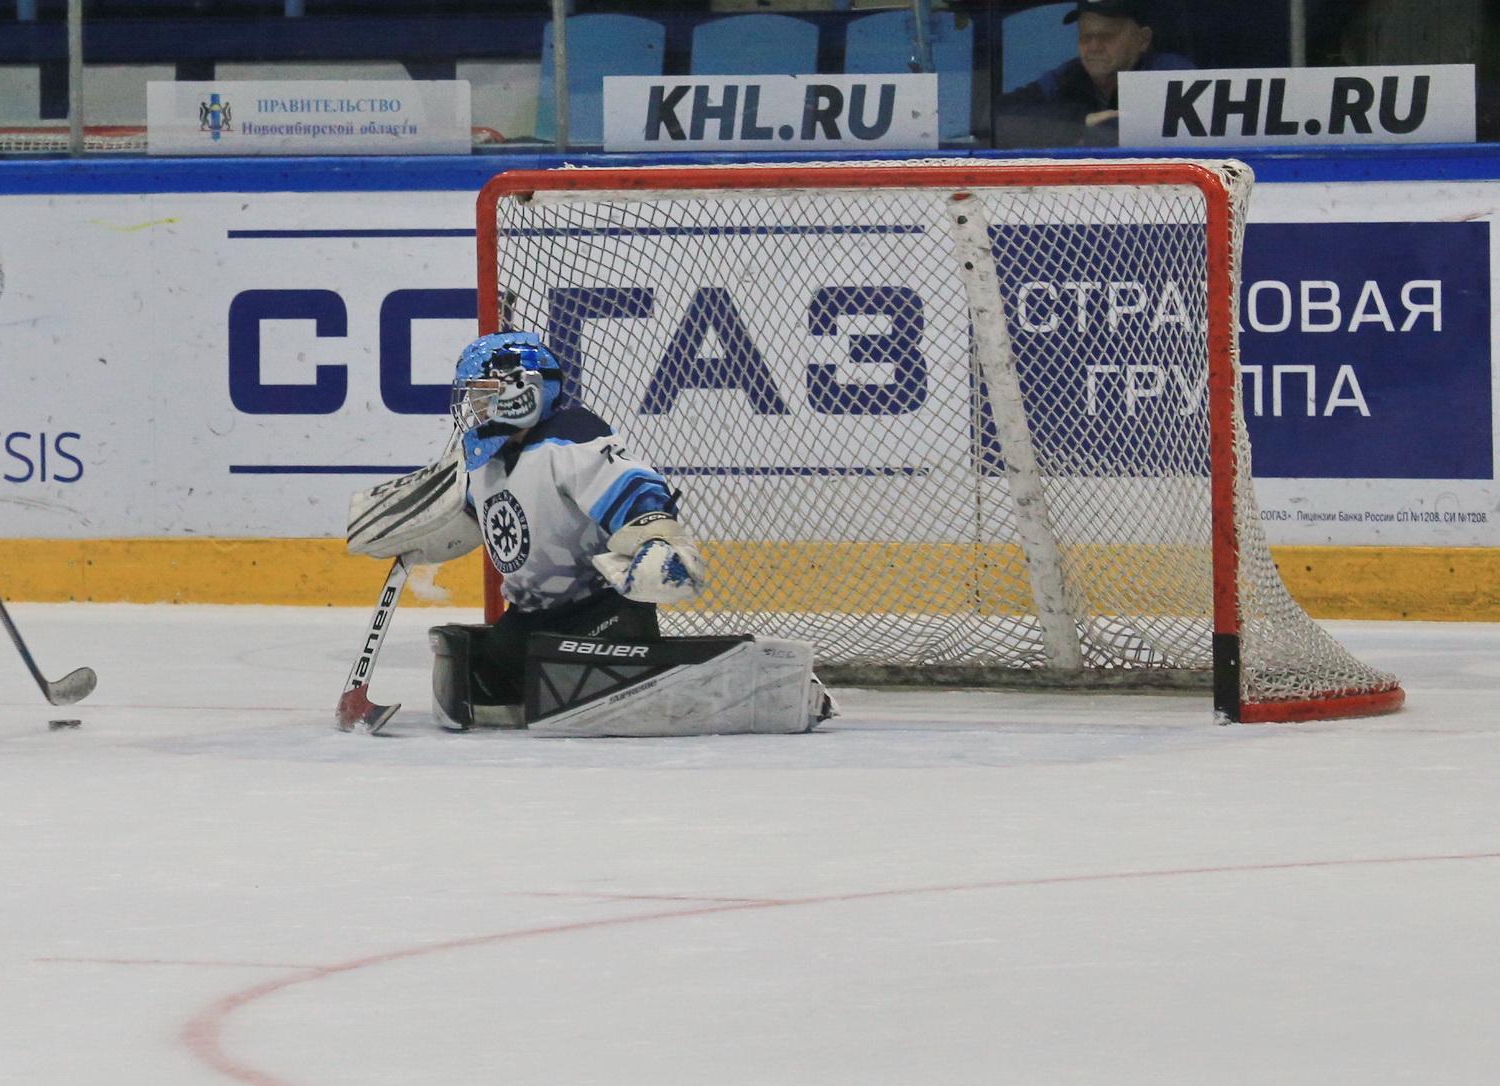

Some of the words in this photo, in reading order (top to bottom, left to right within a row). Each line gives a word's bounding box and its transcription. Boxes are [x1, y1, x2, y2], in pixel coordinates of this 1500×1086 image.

[257, 98, 401, 113] ПРАВИТЕЛЬСТВО
[644, 83, 896, 141] KHL.RU
[1162, 75, 1430, 138] KHL.RU
[241, 120, 354, 136] Новосибирской
[360, 120, 417, 136] области
[228, 286, 928, 415] СОГАЗ
[1338, 511, 1363, 522] Банка
[1364, 511, 1395, 522] России
